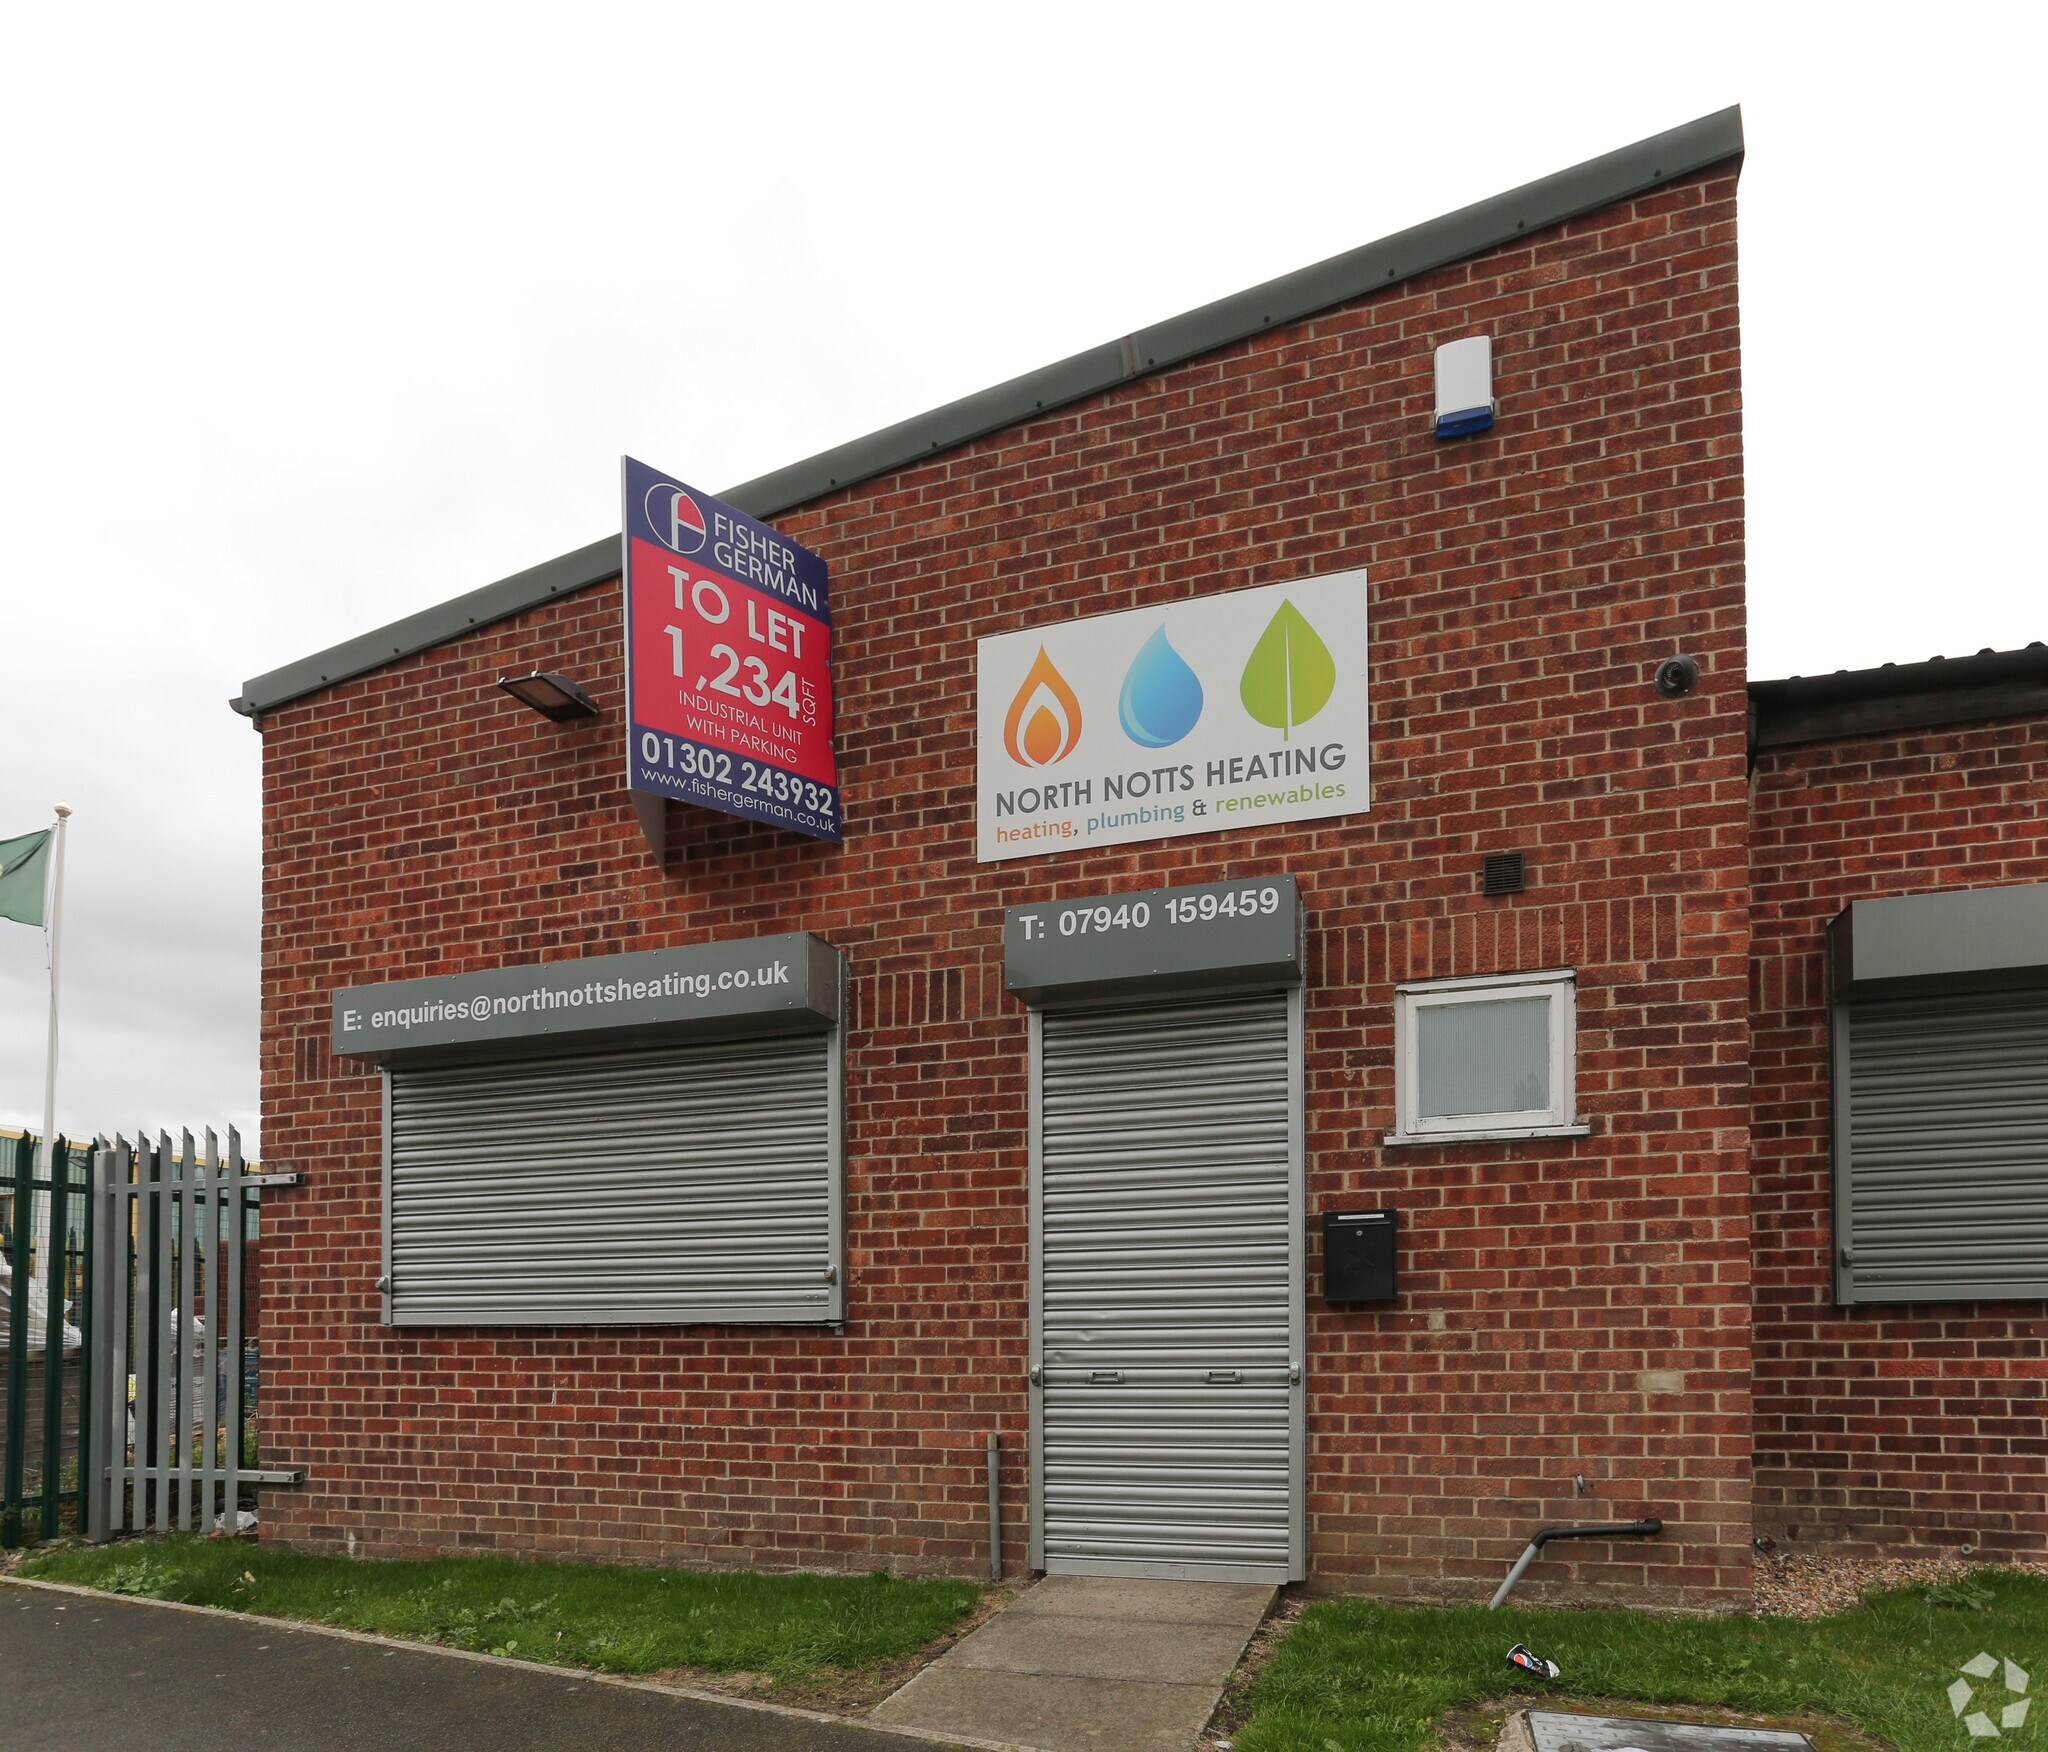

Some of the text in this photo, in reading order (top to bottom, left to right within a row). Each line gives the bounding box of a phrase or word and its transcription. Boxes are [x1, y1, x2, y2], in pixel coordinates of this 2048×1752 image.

[713, 541, 818, 611] GERMAN
[714, 511, 796, 576] FISHER
[667, 565, 806, 660] TO LET
[663, 624, 800, 719] 1,234
[679, 689, 803, 746] INDUSTRIAL UNIT
[686, 714, 798, 764] WITH PARKING
[641, 732, 833, 817] 01302 243932
[641, 767, 836, 834] www.fishergerman.co.uk
[996, 743, 1346, 817] NORTH NOTTS HEATING
[996, 782, 1346, 844] heating, plumbing & renewables
[1018, 886, 1280, 940] T: 07940 159459
[342, 960, 790, 1031] E: enquiries@northnottsheating.co.uk
